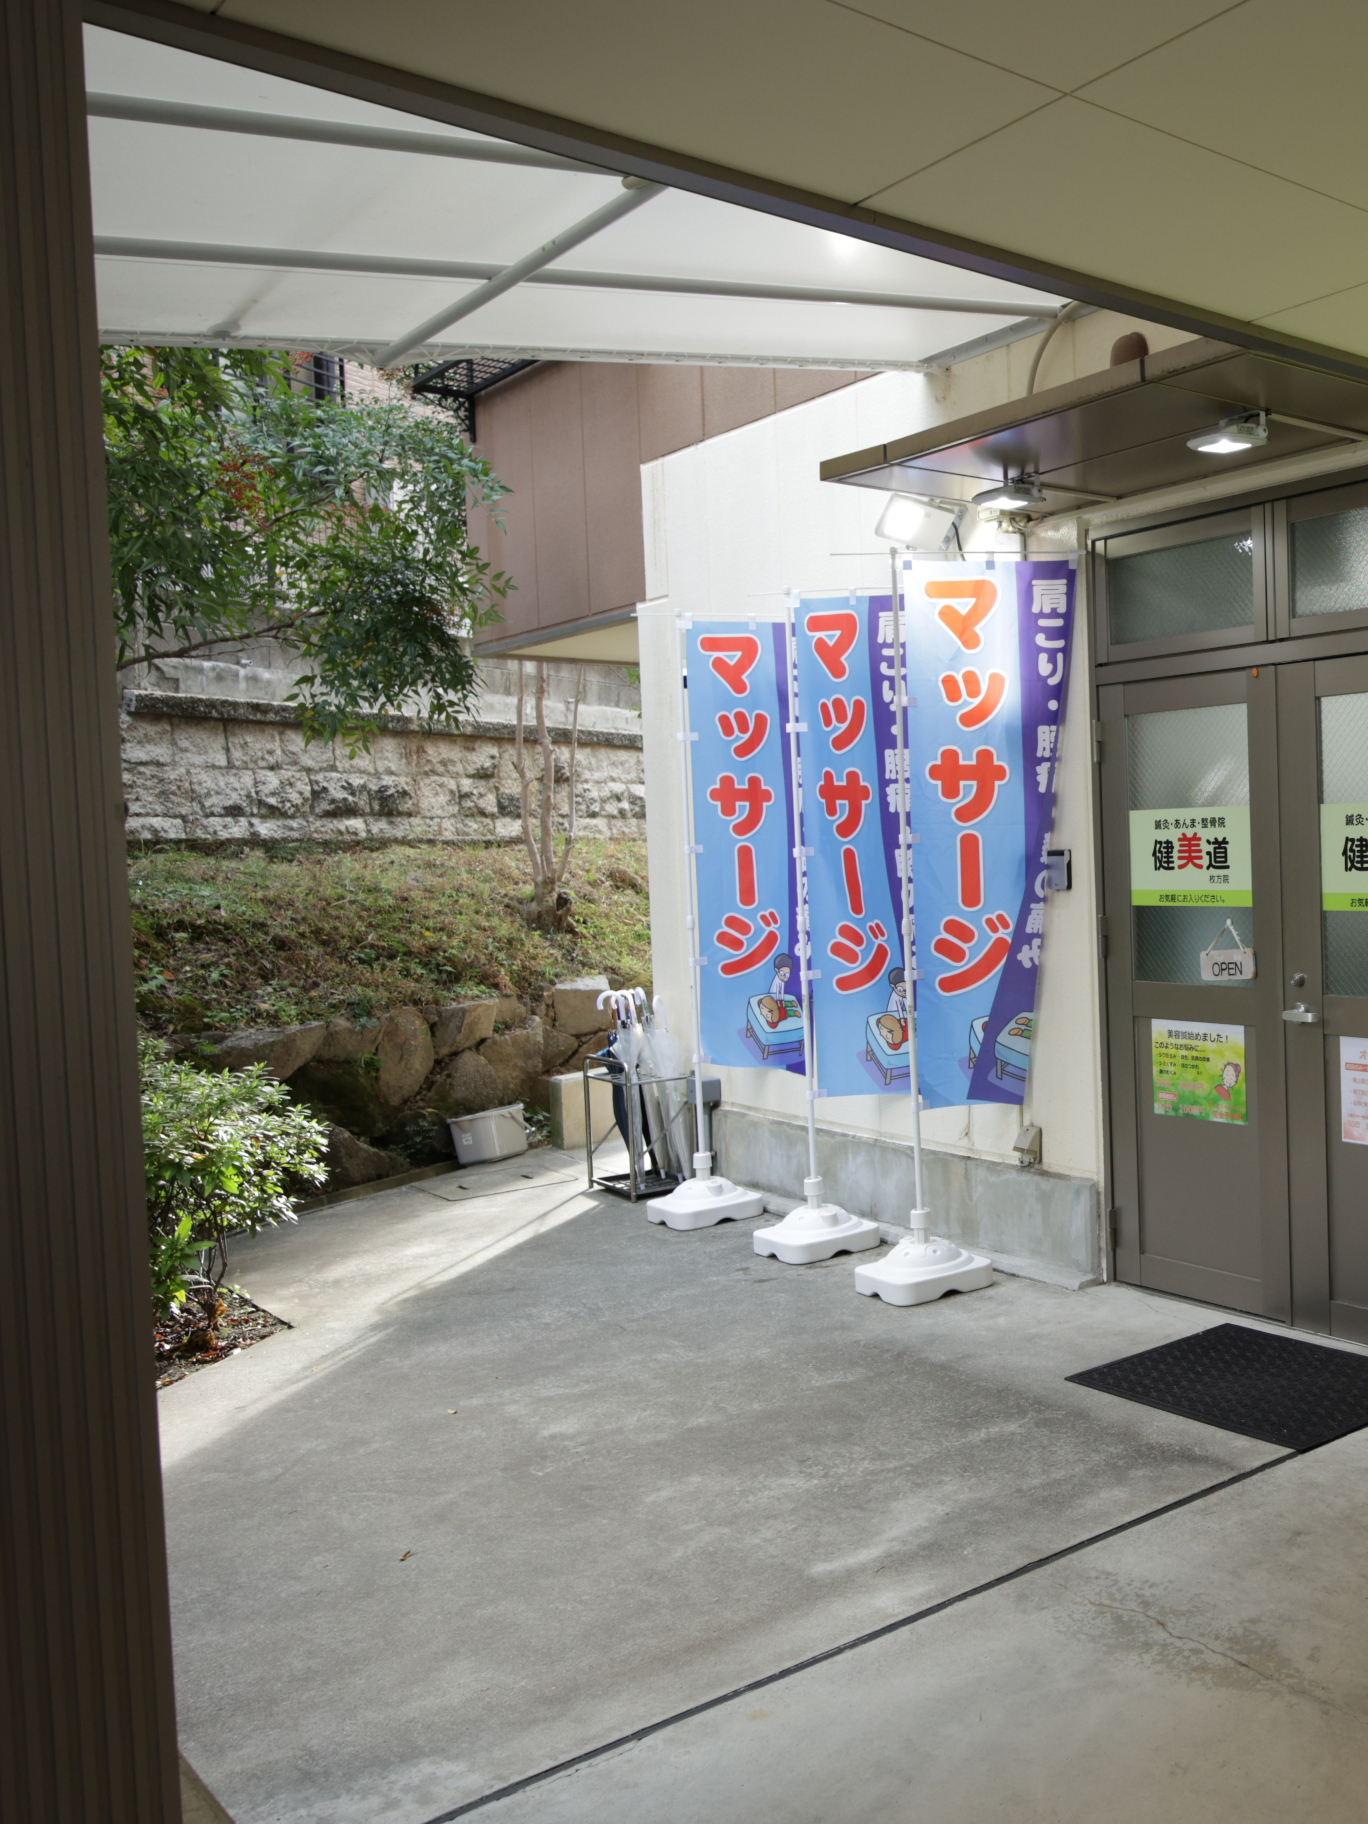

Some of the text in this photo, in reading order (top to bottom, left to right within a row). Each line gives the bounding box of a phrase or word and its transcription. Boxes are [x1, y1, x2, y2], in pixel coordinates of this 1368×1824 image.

[698, 633, 781, 978] マッサージ
[804, 610, 891, 995] マッサージ
[922, 575, 1014, 997] マッサージ
[1151, 832, 1231, 872] 健美道
[1208, 874, 1230, 885] 枚方院
[1211, 961, 1243, 977] OPEN
